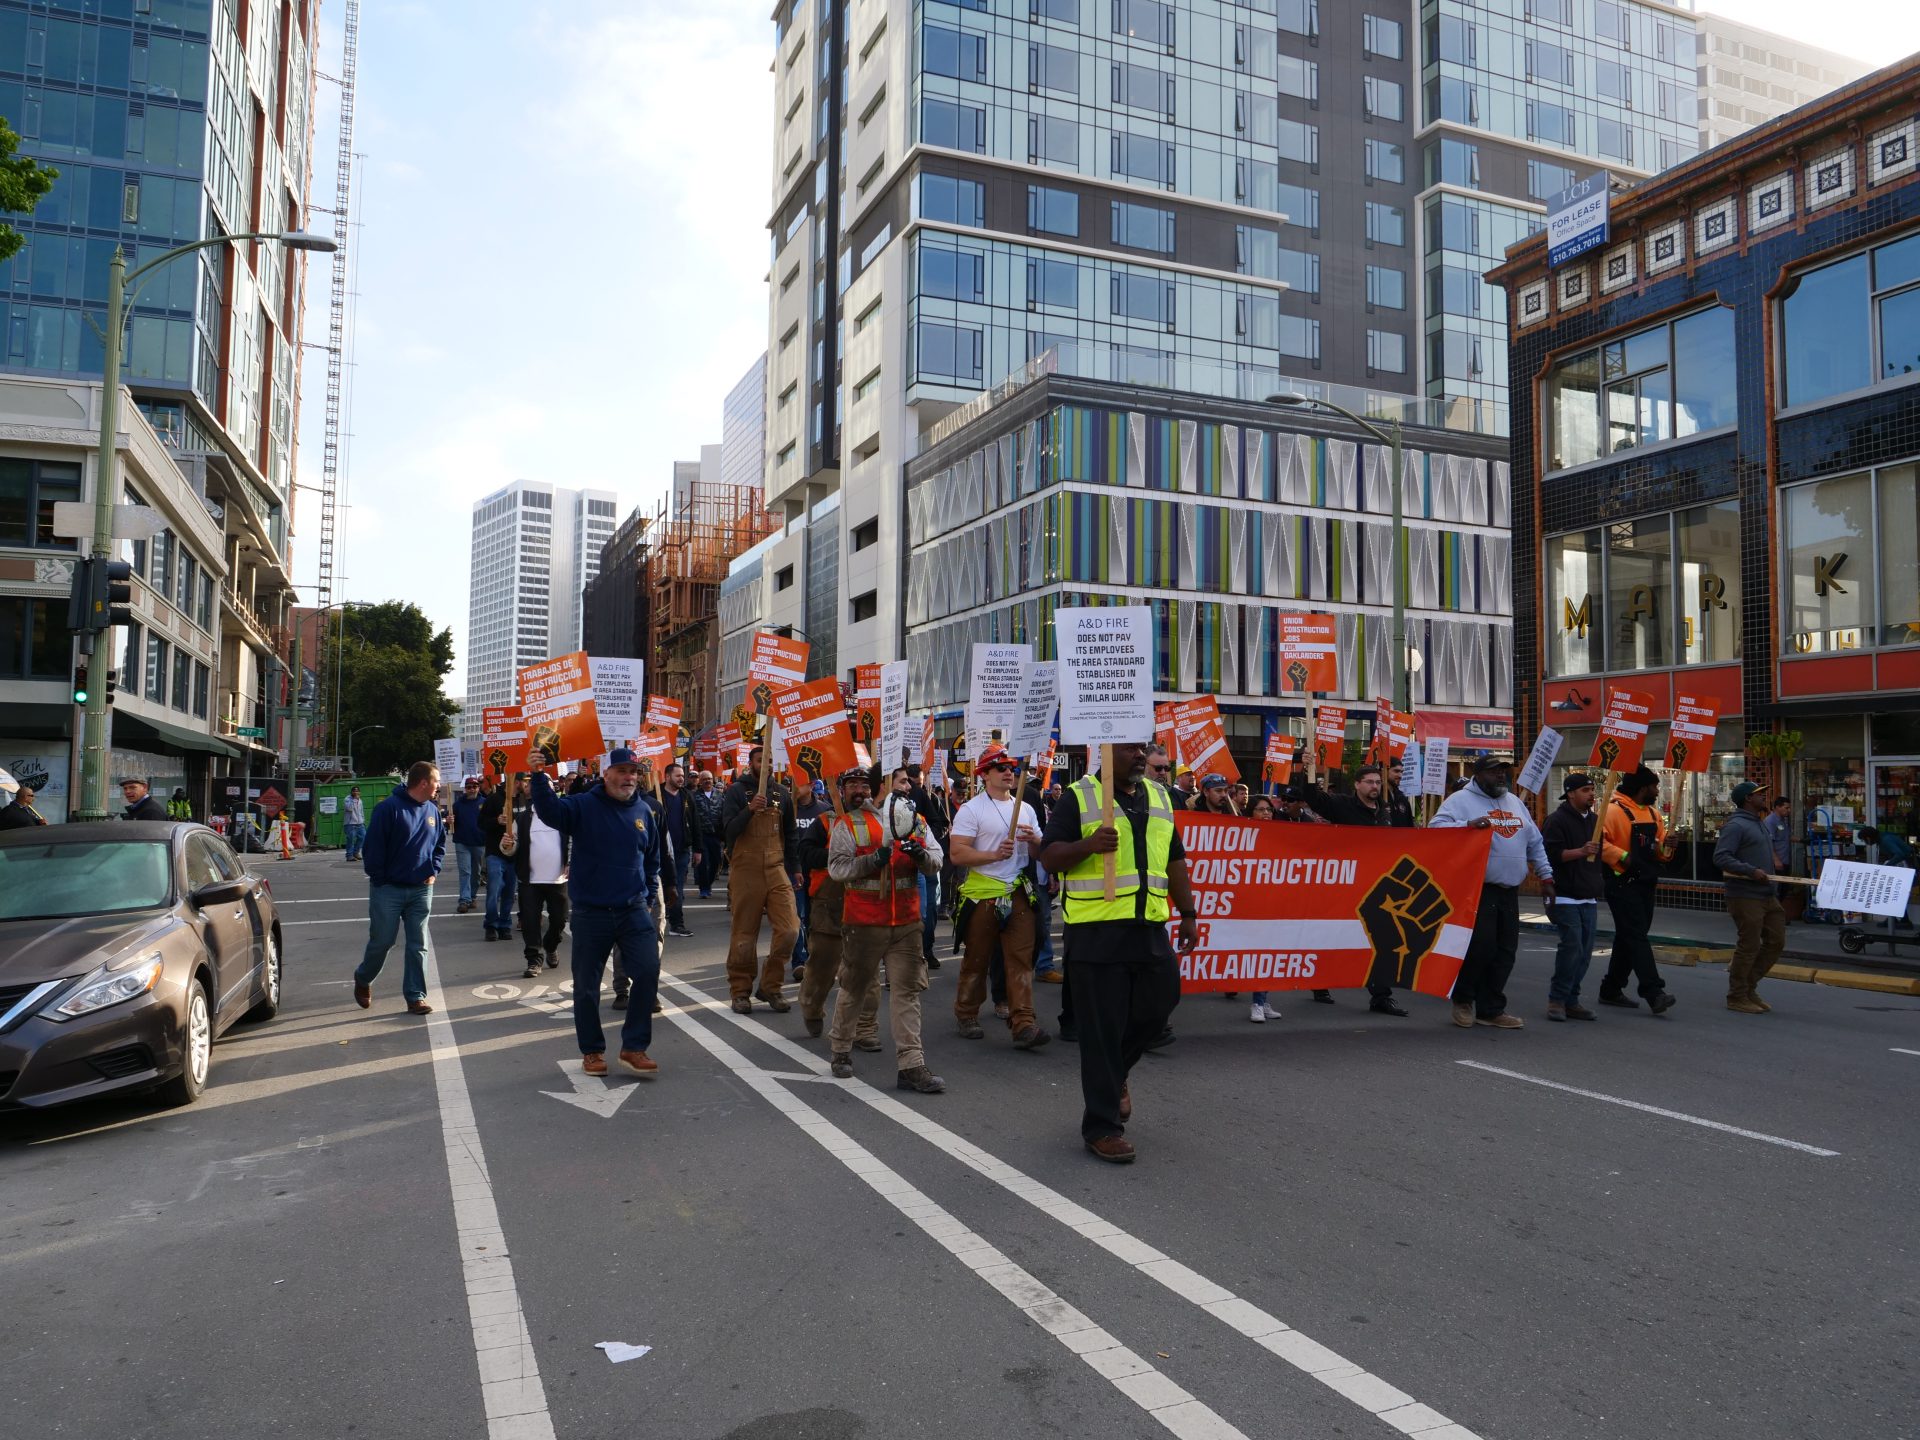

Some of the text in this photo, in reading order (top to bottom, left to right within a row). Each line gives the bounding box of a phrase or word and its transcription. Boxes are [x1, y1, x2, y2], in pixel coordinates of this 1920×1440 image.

[1562, 180, 1590, 205] LCB
[1552, 200, 1601, 231] FOR LEASE
[1556, 214, 1596, 238] Office Space
[1078, 618, 1128, 628] A&D FIRE
[758, 636, 778, 646] UNION
[1078, 633, 1131, 642] DOES NOT PAY
[757, 646, 802, 662] CONSTRUCTION
[1076, 645, 1134, 654] ITS EMPLOYEES
[756, 655, 772, 664] JOBS
[1082, 658, 1101, 666] AREA
[1104, 657, 1144, 666] STANDARD
[522, 659, 573, 680] TRABAJOS DE
[1077, 670, 1125, 678] ESTABLISHED
[524, 668, 582, 692] CONSTRUCCIÓN
[753, 672, 792, 687] OAKLANDERS
[1078, 682, 1094, 690] THIS
[1096, 682, 1116, 690] AREA
[525, 682, 573, 704] DE LA UNIÓN
[776, 691, 800, 705] UNION
[1079, 693, 1135, 702] SIMILAR WORK
[1614, 691, 1631, 700] UNION
[527, 703, 547, 714] PARA
[780, 693, 834, 715] CONSTRUCTION
[1173, 704, 1189, 713] UNION
[1611, 701, 1648, 714] CONSTRUCTION
[528, 705, 580, 727] OAKLANDERS
[1176, 706, 1213, 720] CONSTRUCTION
[1678, 706, 1714, 716] CONSTRUCTION
[784, 714, 802, 726] JOBS
[786, 726, 800, 736] FOR
[789, 725, 836, 747] OAKLANDERS
[1470, 724, 1513, 736] SUFF
[1603, 728, 1637, 740] OAKLANDERS
[1673, 731, 1702, 740] OAKLANDERS
[487, 739, 523, 747] OAKLANDERS
[9, 758, 46, 777] Rush
[1182, 826, 1260, 851] UNION
[1170, 923, 1211, 948] FR
[1180, 954, 1317, 980] AKLANDERS
